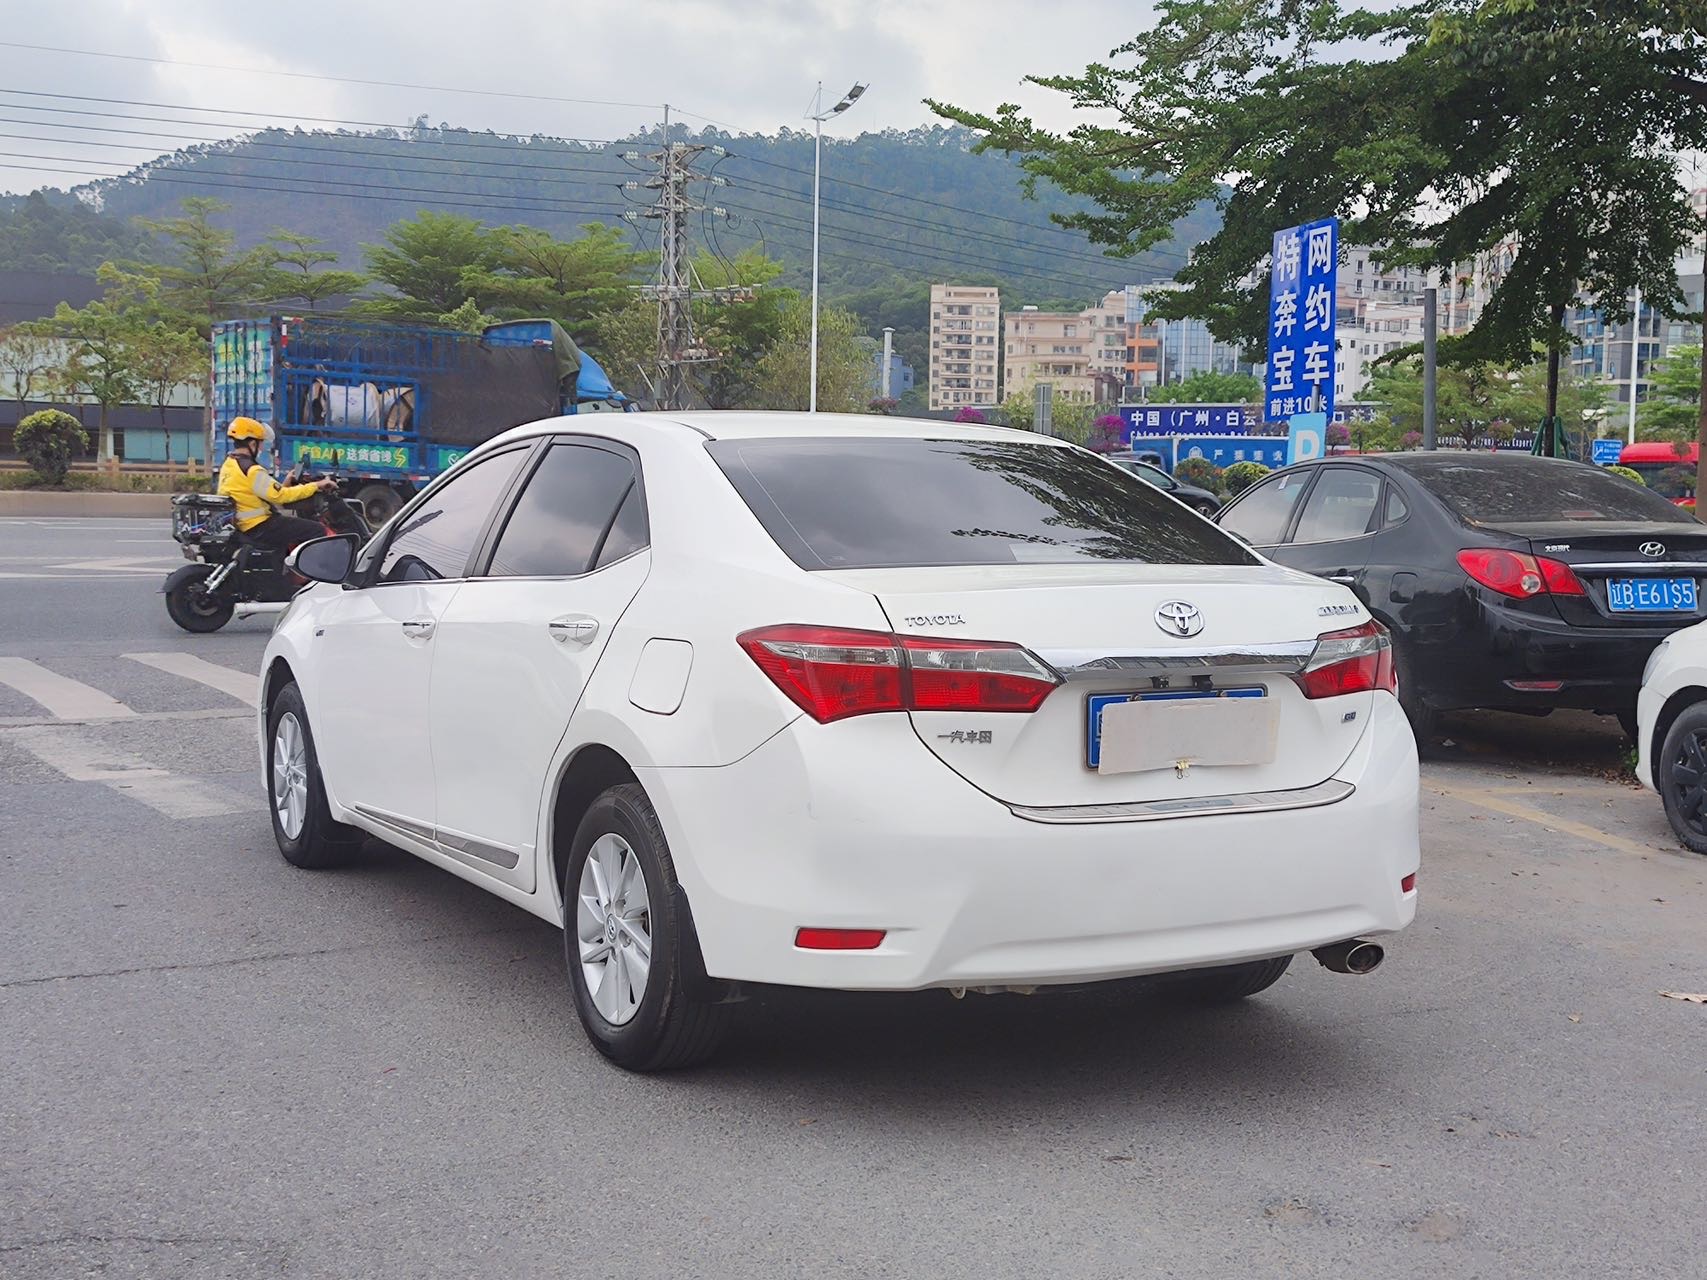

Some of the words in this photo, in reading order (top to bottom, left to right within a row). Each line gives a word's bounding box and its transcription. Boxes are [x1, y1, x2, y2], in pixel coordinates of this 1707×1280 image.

[1271, 233, 1300, 392] 特奔宝
[1303, 225, 1332, 385] 网约车
[904, 614, 966, 627] TOYOTA
